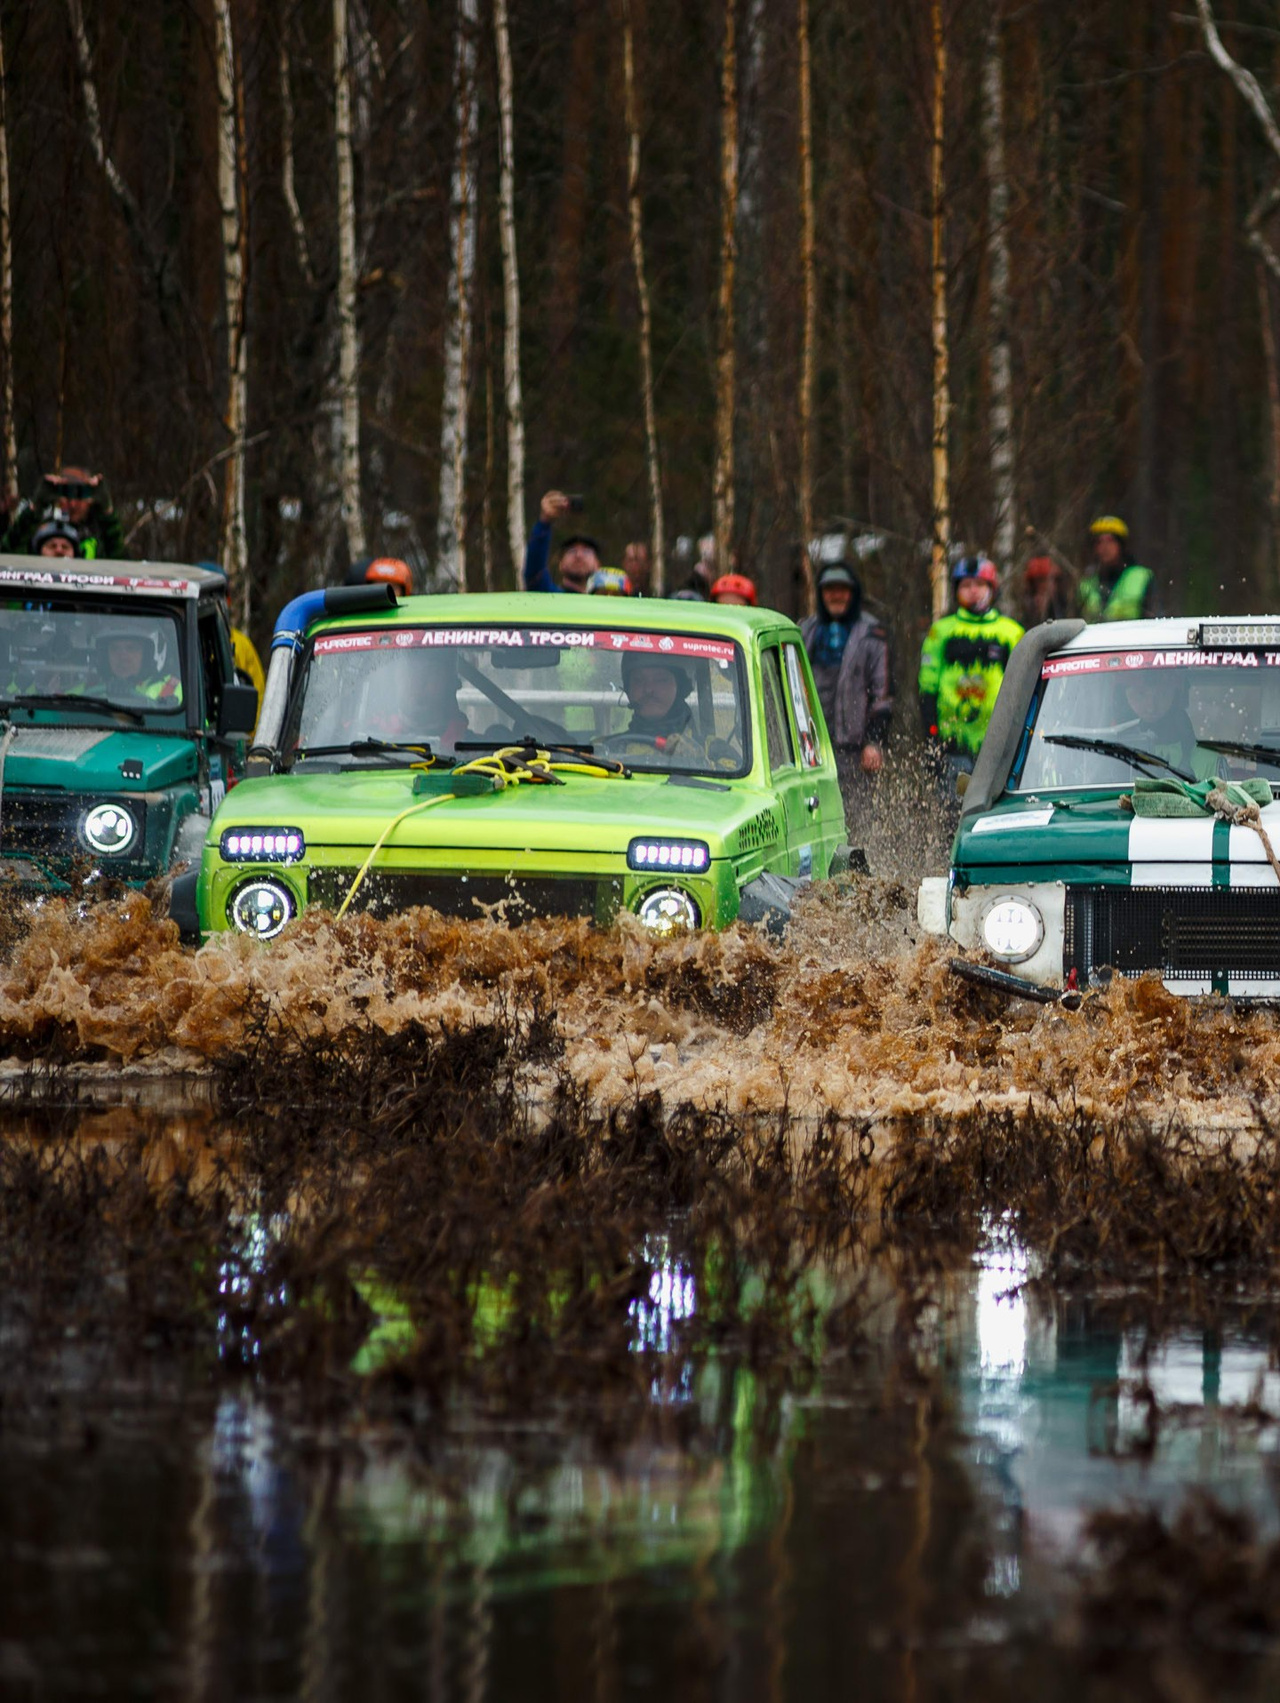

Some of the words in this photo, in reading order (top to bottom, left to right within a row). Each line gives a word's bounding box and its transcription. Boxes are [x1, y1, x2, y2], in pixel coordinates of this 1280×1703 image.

[59, 573, 115, 586] ТРОФИ
[421, 630, 523, 647] ЛЕНИНГРАД
[529, 630, 595, 647] ТРОФИ
[682, 641, 735, 657] suprotec.ru
[1152, 651, 1259, 667] ЛЕНИНГРАД
